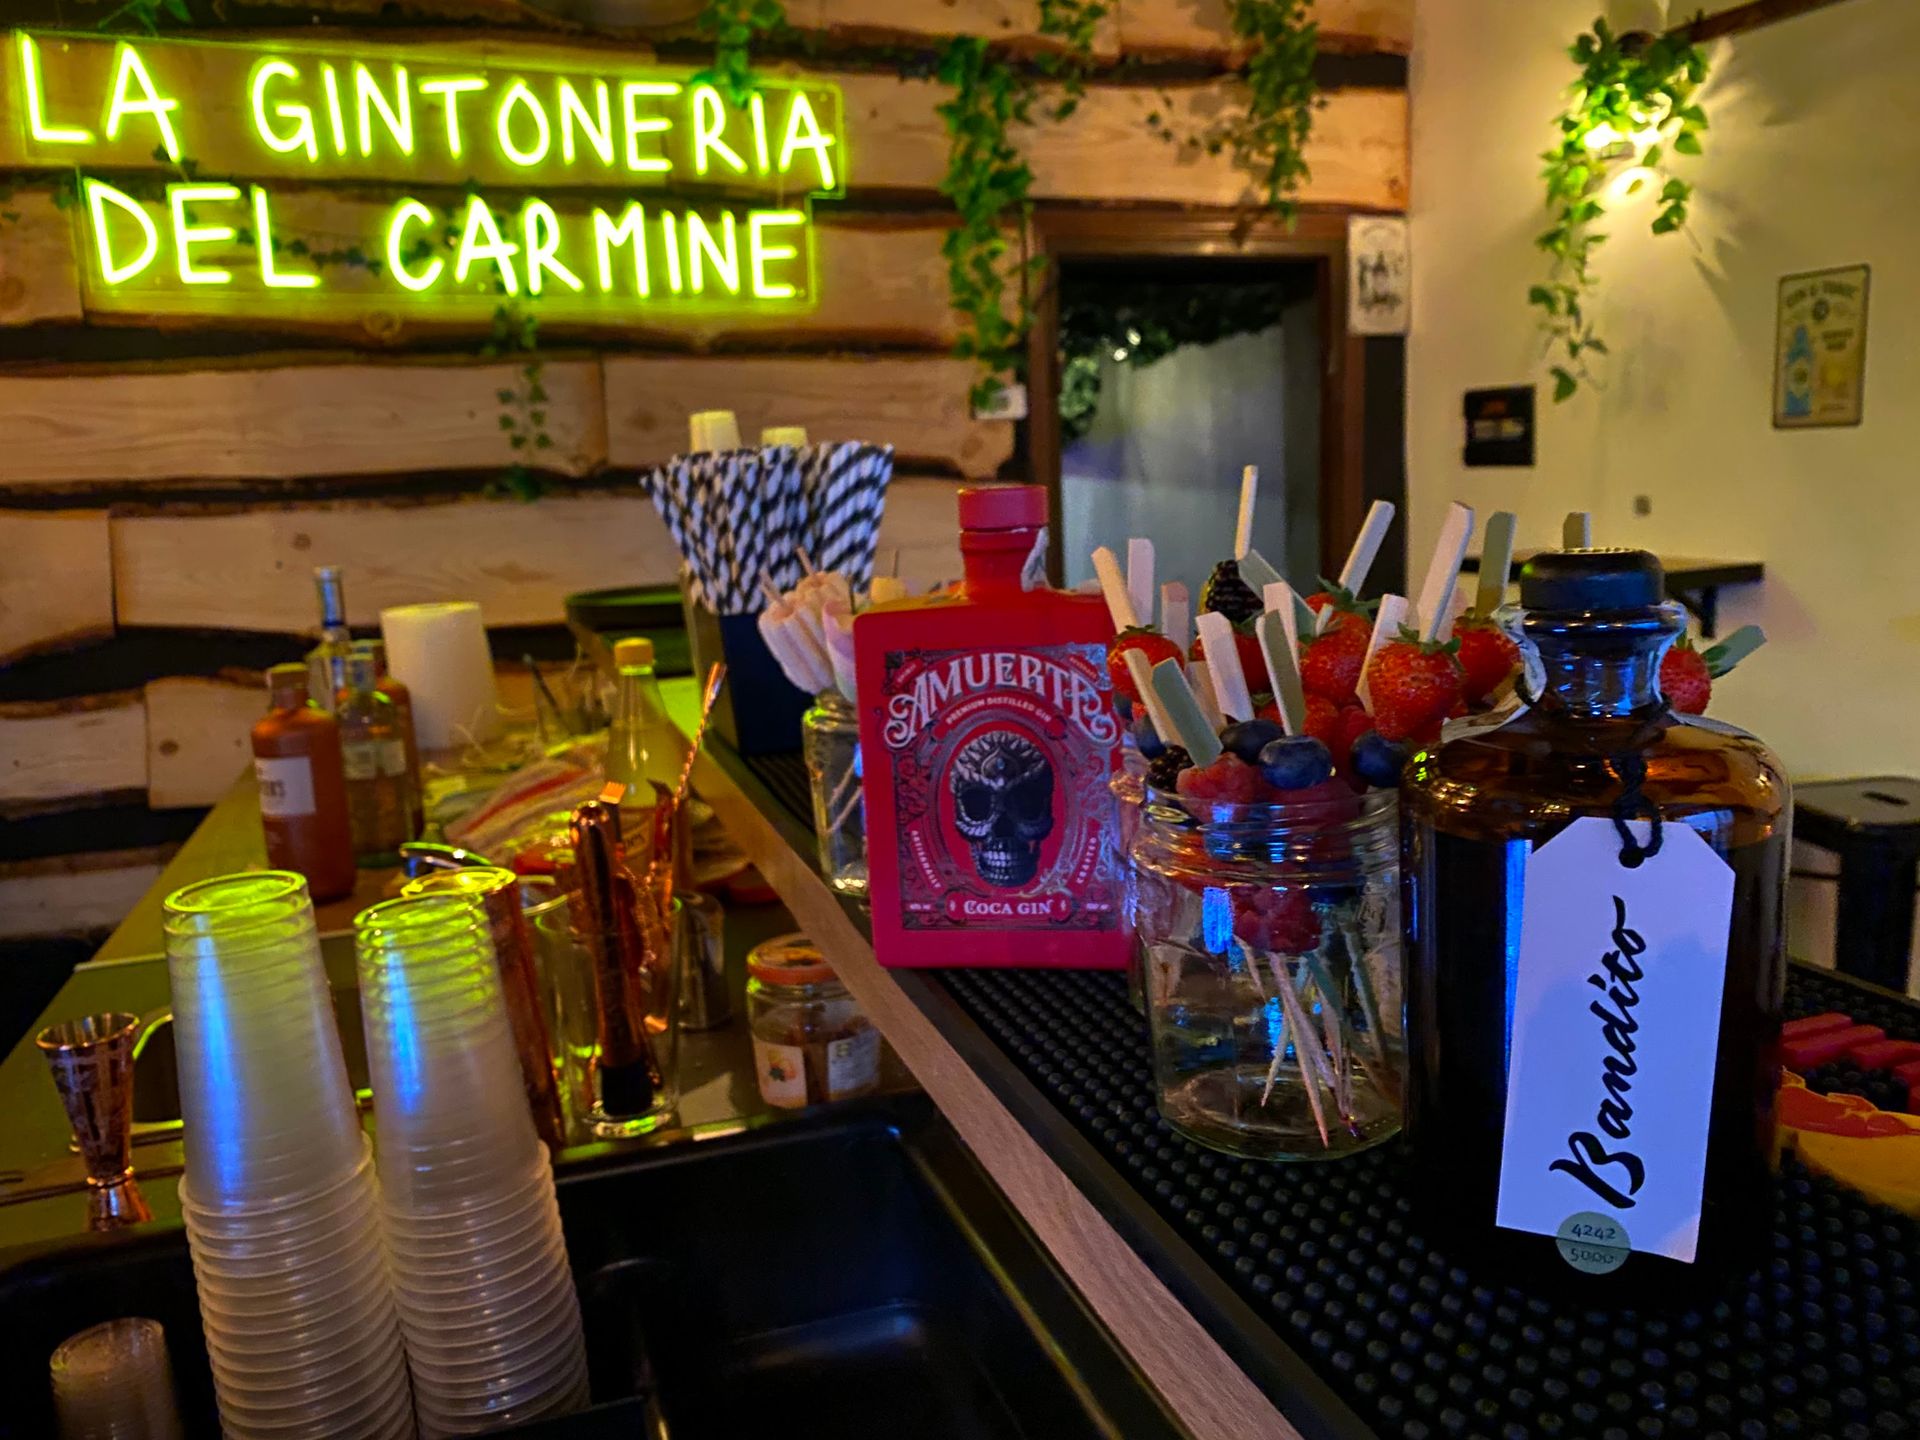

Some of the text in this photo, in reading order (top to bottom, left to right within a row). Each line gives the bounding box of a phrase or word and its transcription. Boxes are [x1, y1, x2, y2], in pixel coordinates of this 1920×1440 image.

[19, 33, 837, 191] LA GINTONERIA
[84, 178, 807, 298] DEL CARMINE
[987, 697, 1035, 711] DISTILLED
[1035, 708, 1052, 722] GIN
[1077, 837, 1097, 884] CRAFTED
[1017, 899, 1054, 915] GIN
[1549, 895, 1646, 1209] Bandito
[1571, 1224, 1616, 1240] 4242
[1571, 1248, 1615, 1264] 5000
